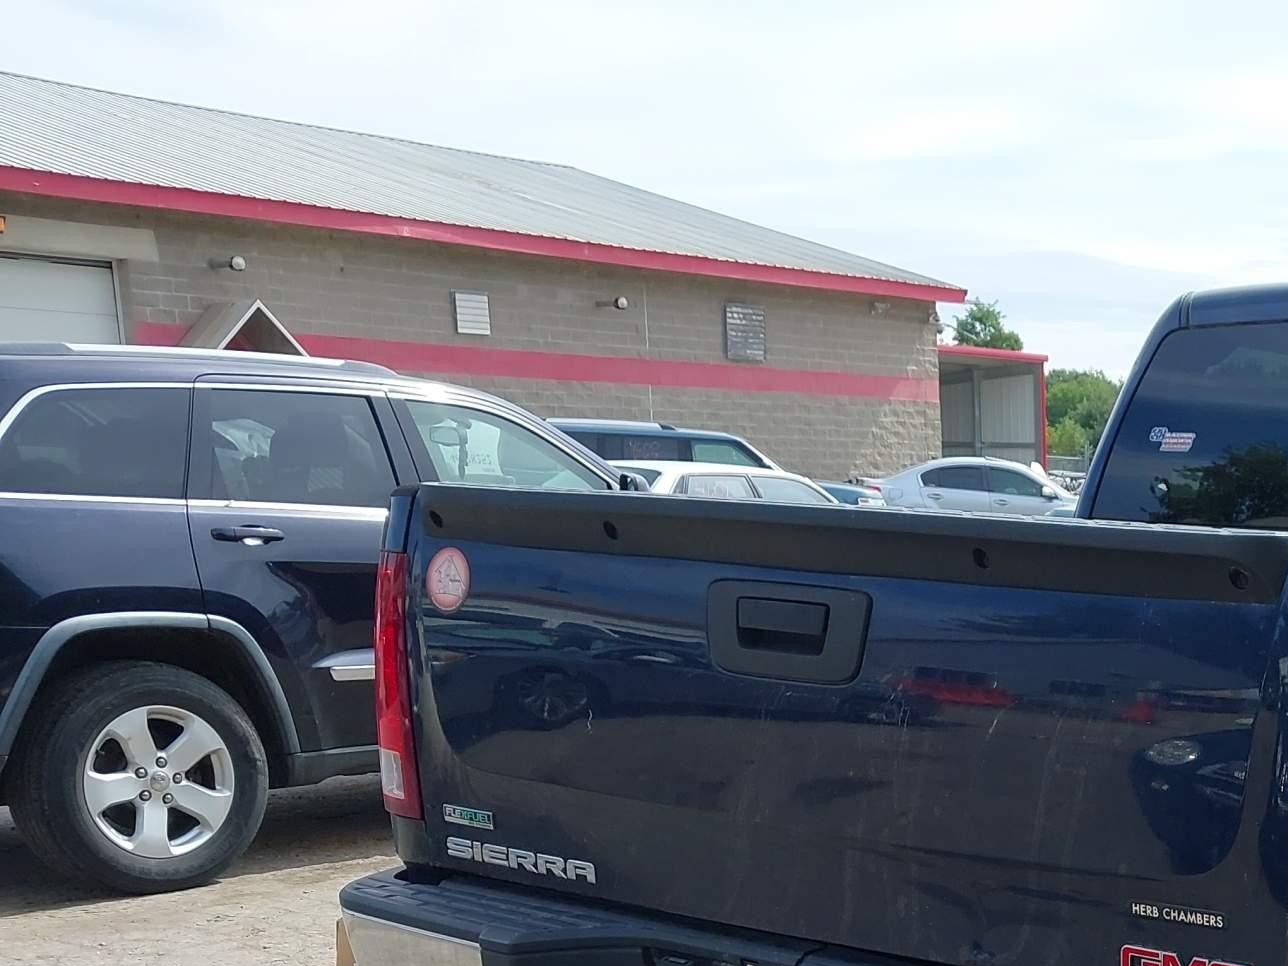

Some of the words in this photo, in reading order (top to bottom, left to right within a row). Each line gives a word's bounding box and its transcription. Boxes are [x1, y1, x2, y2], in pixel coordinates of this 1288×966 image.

[446, 836, 597, 885] SIERRA
[1131, 902, 1159, 918] HERB
[1162, 907, 1224, 928] CHAMBERS
